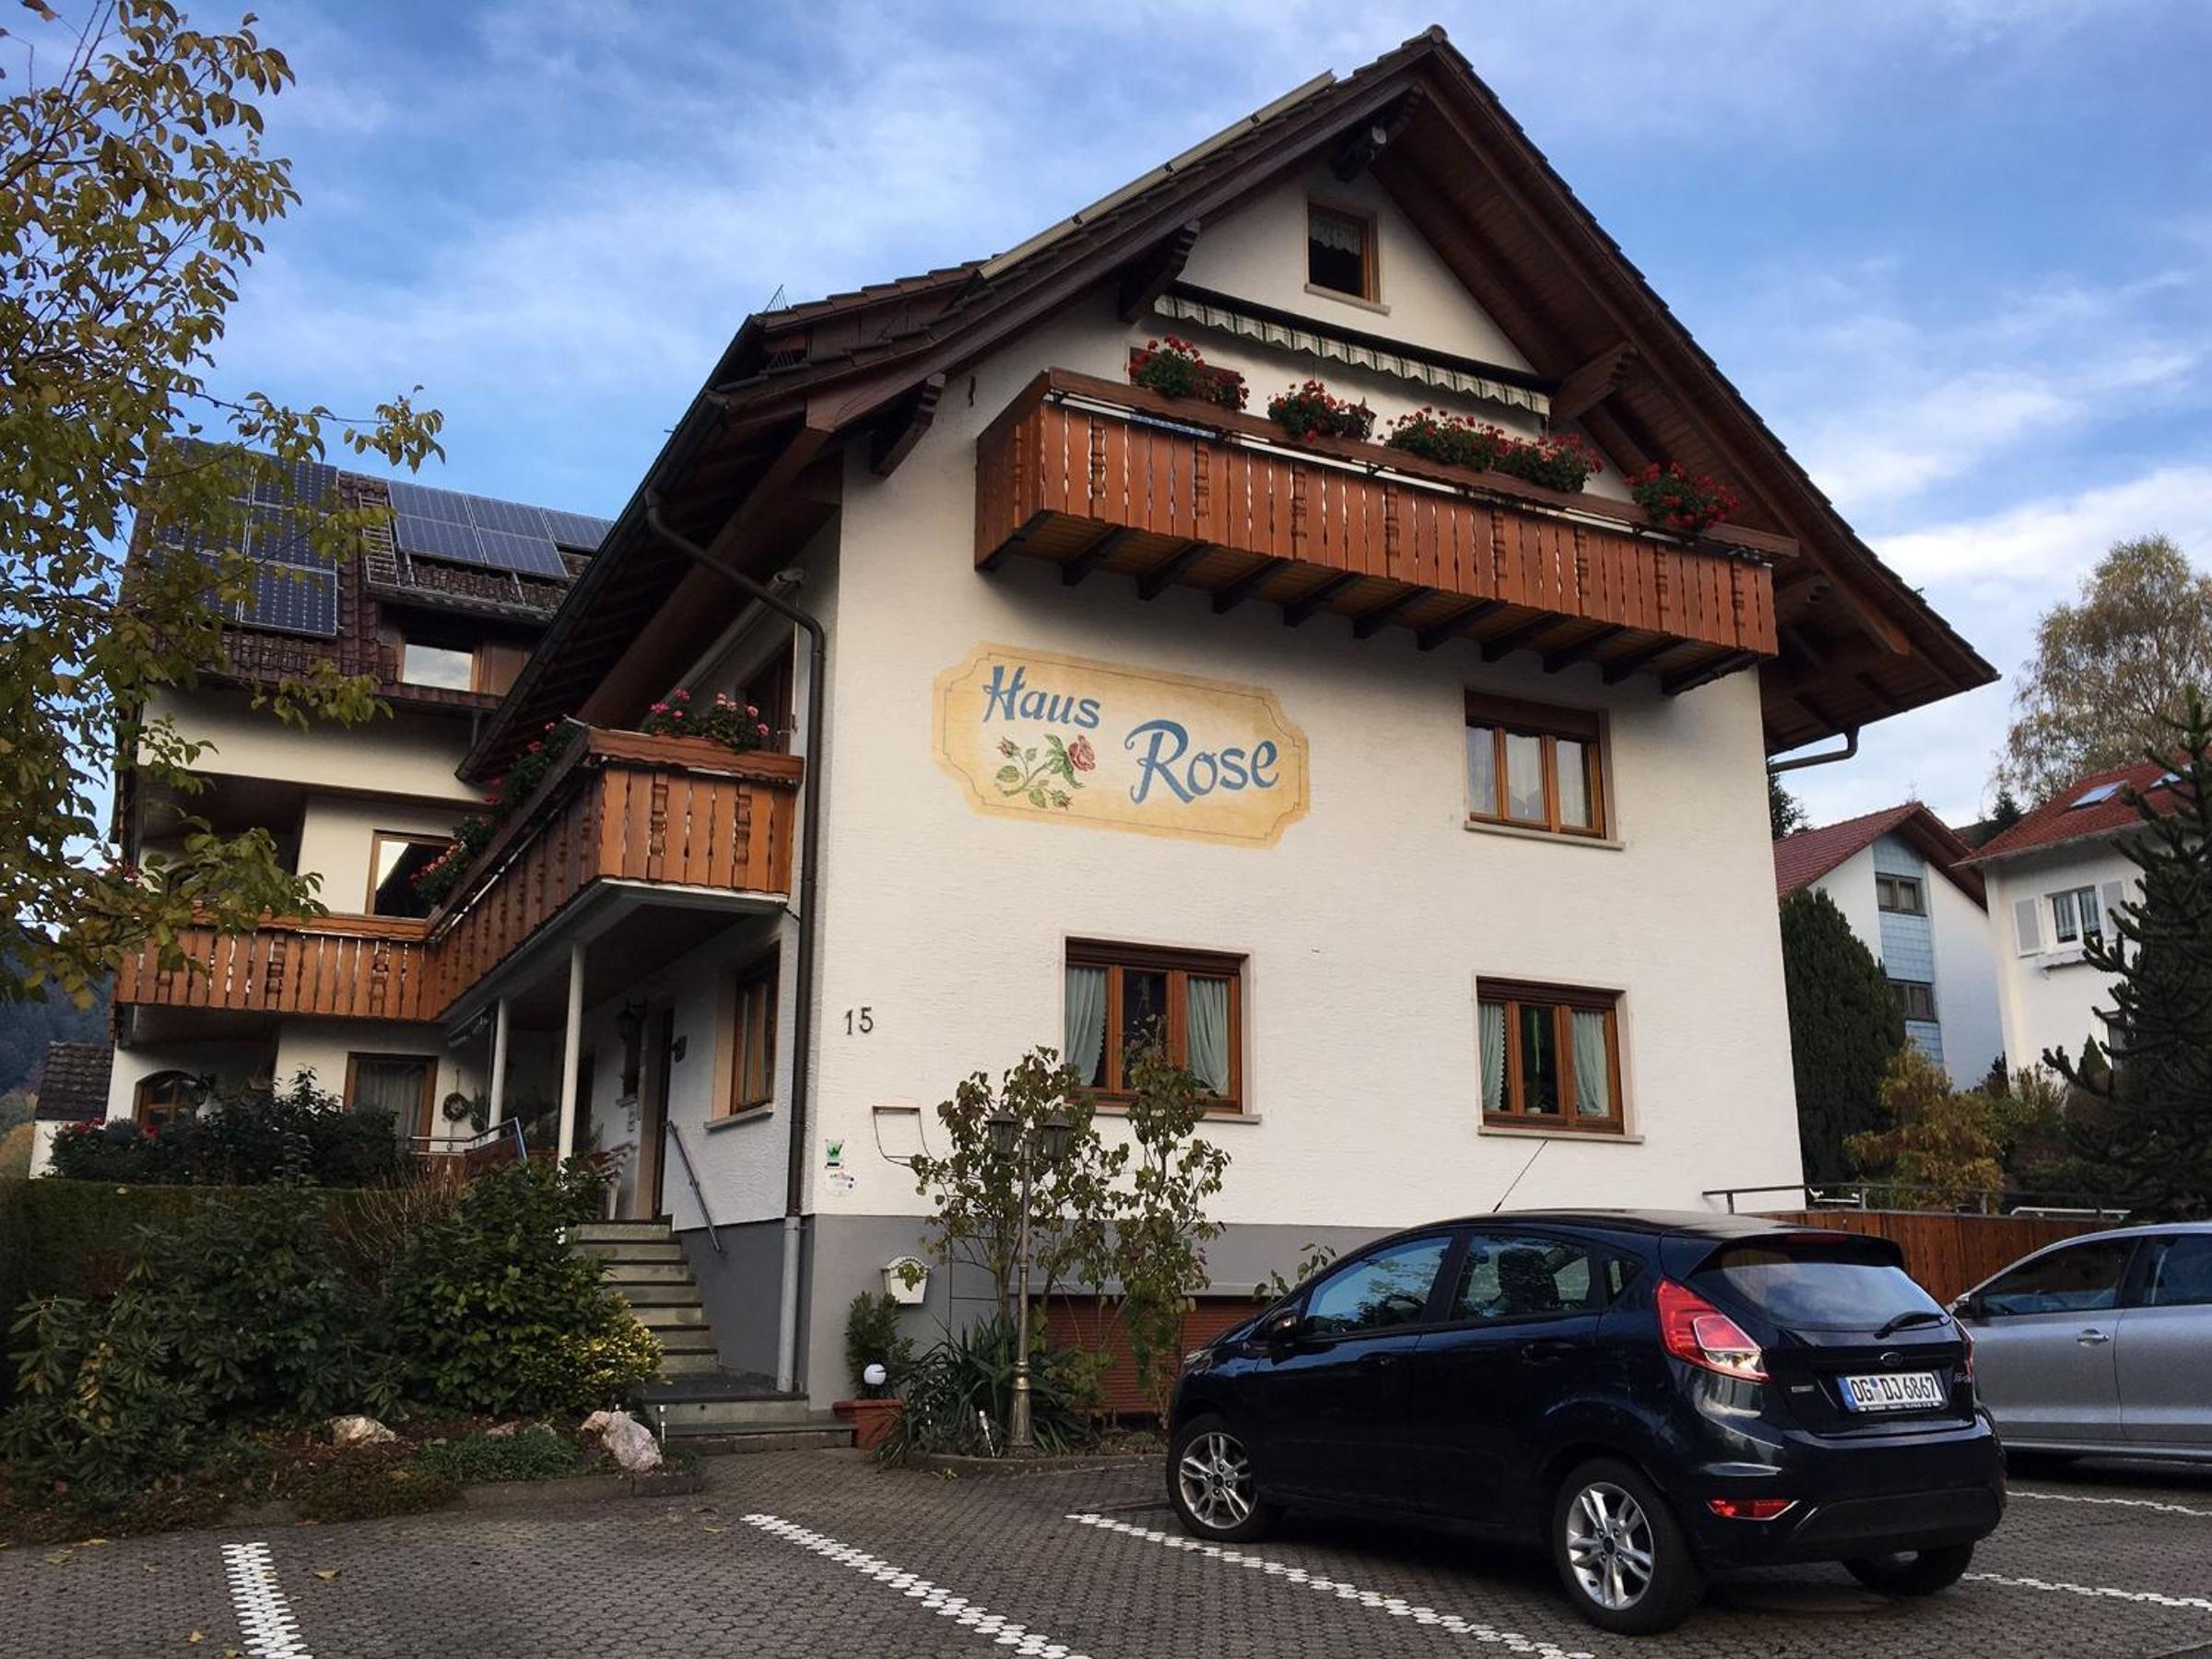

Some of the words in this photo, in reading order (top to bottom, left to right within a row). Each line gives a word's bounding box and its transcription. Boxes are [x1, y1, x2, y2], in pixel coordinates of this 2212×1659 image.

[982, 665, 1101, 729] Haus
[1124, 719, 1279, 804] Rose
[844, 1006, 874, 1035] 15
[1851, 1379, 1874, 1402] OG
